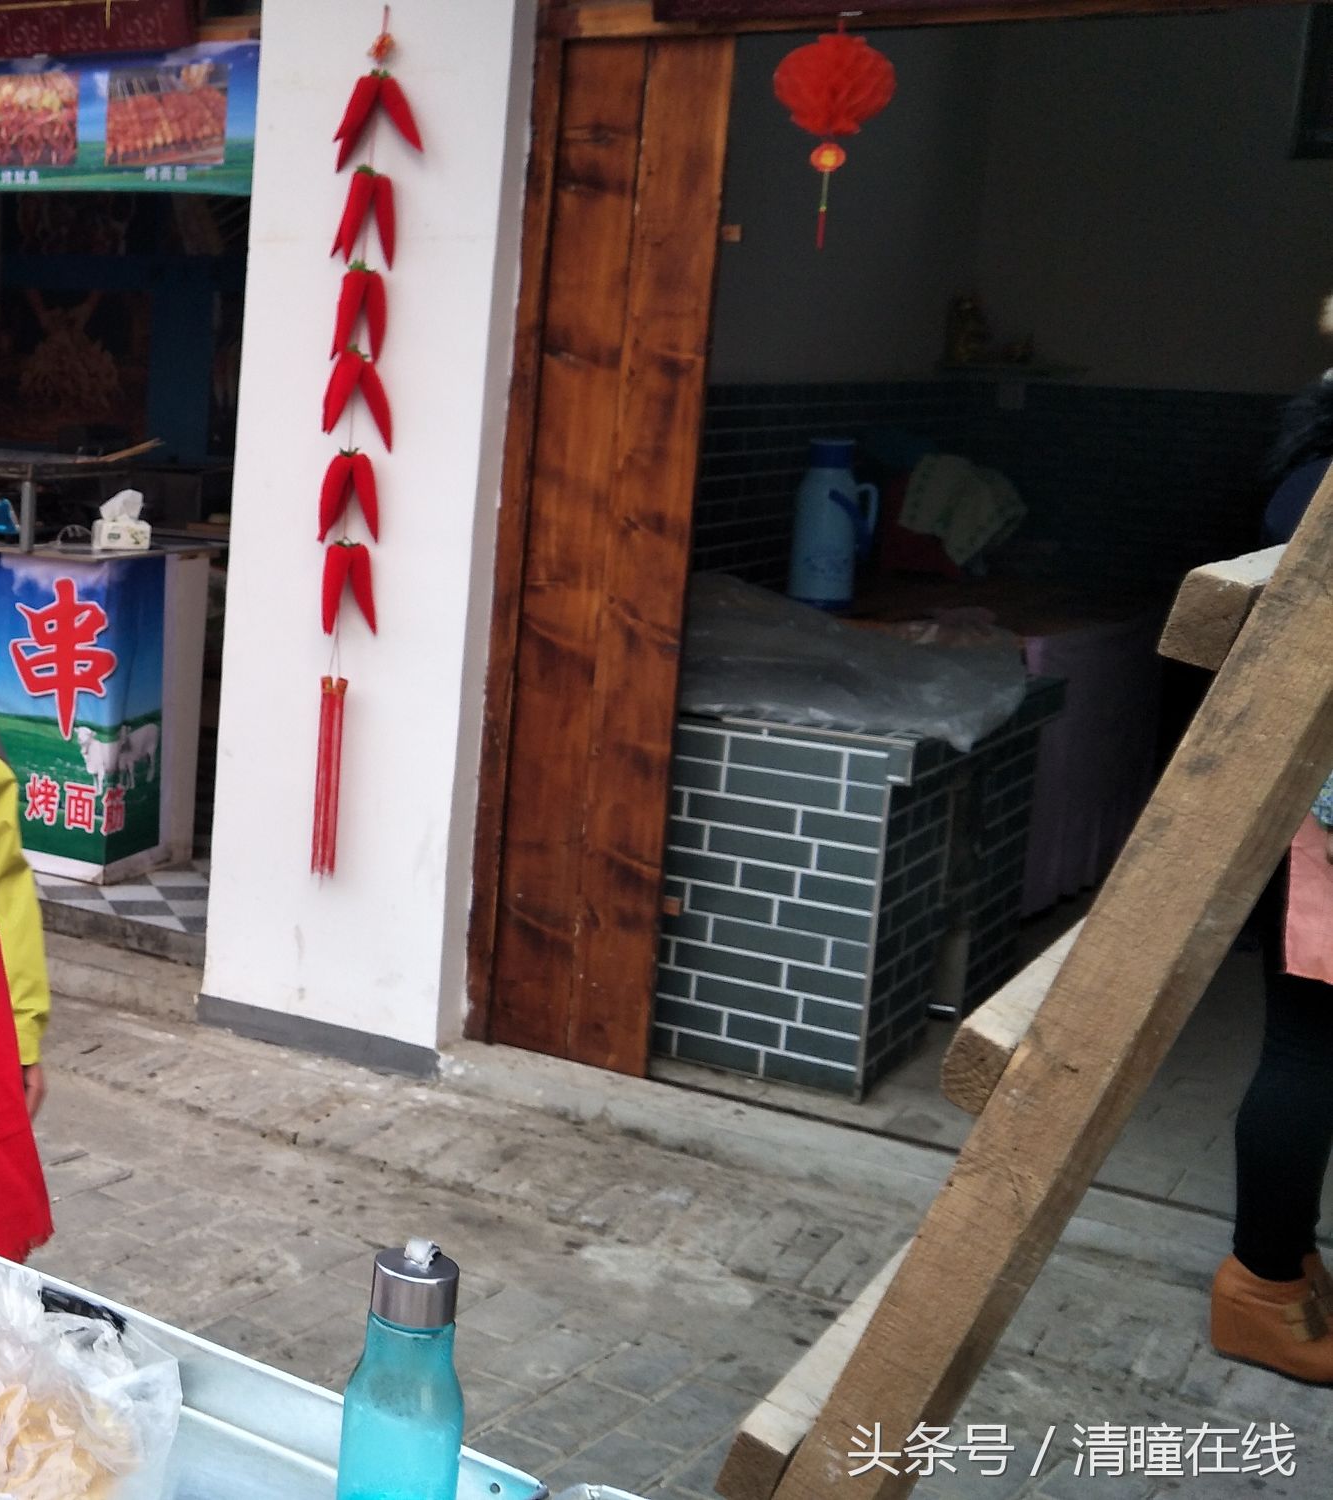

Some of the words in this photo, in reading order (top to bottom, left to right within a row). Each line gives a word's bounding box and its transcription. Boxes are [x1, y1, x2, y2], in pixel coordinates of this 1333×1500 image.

[9, 577, 117, 740] 串
[24, 772, 127, 836] 烤面筋
